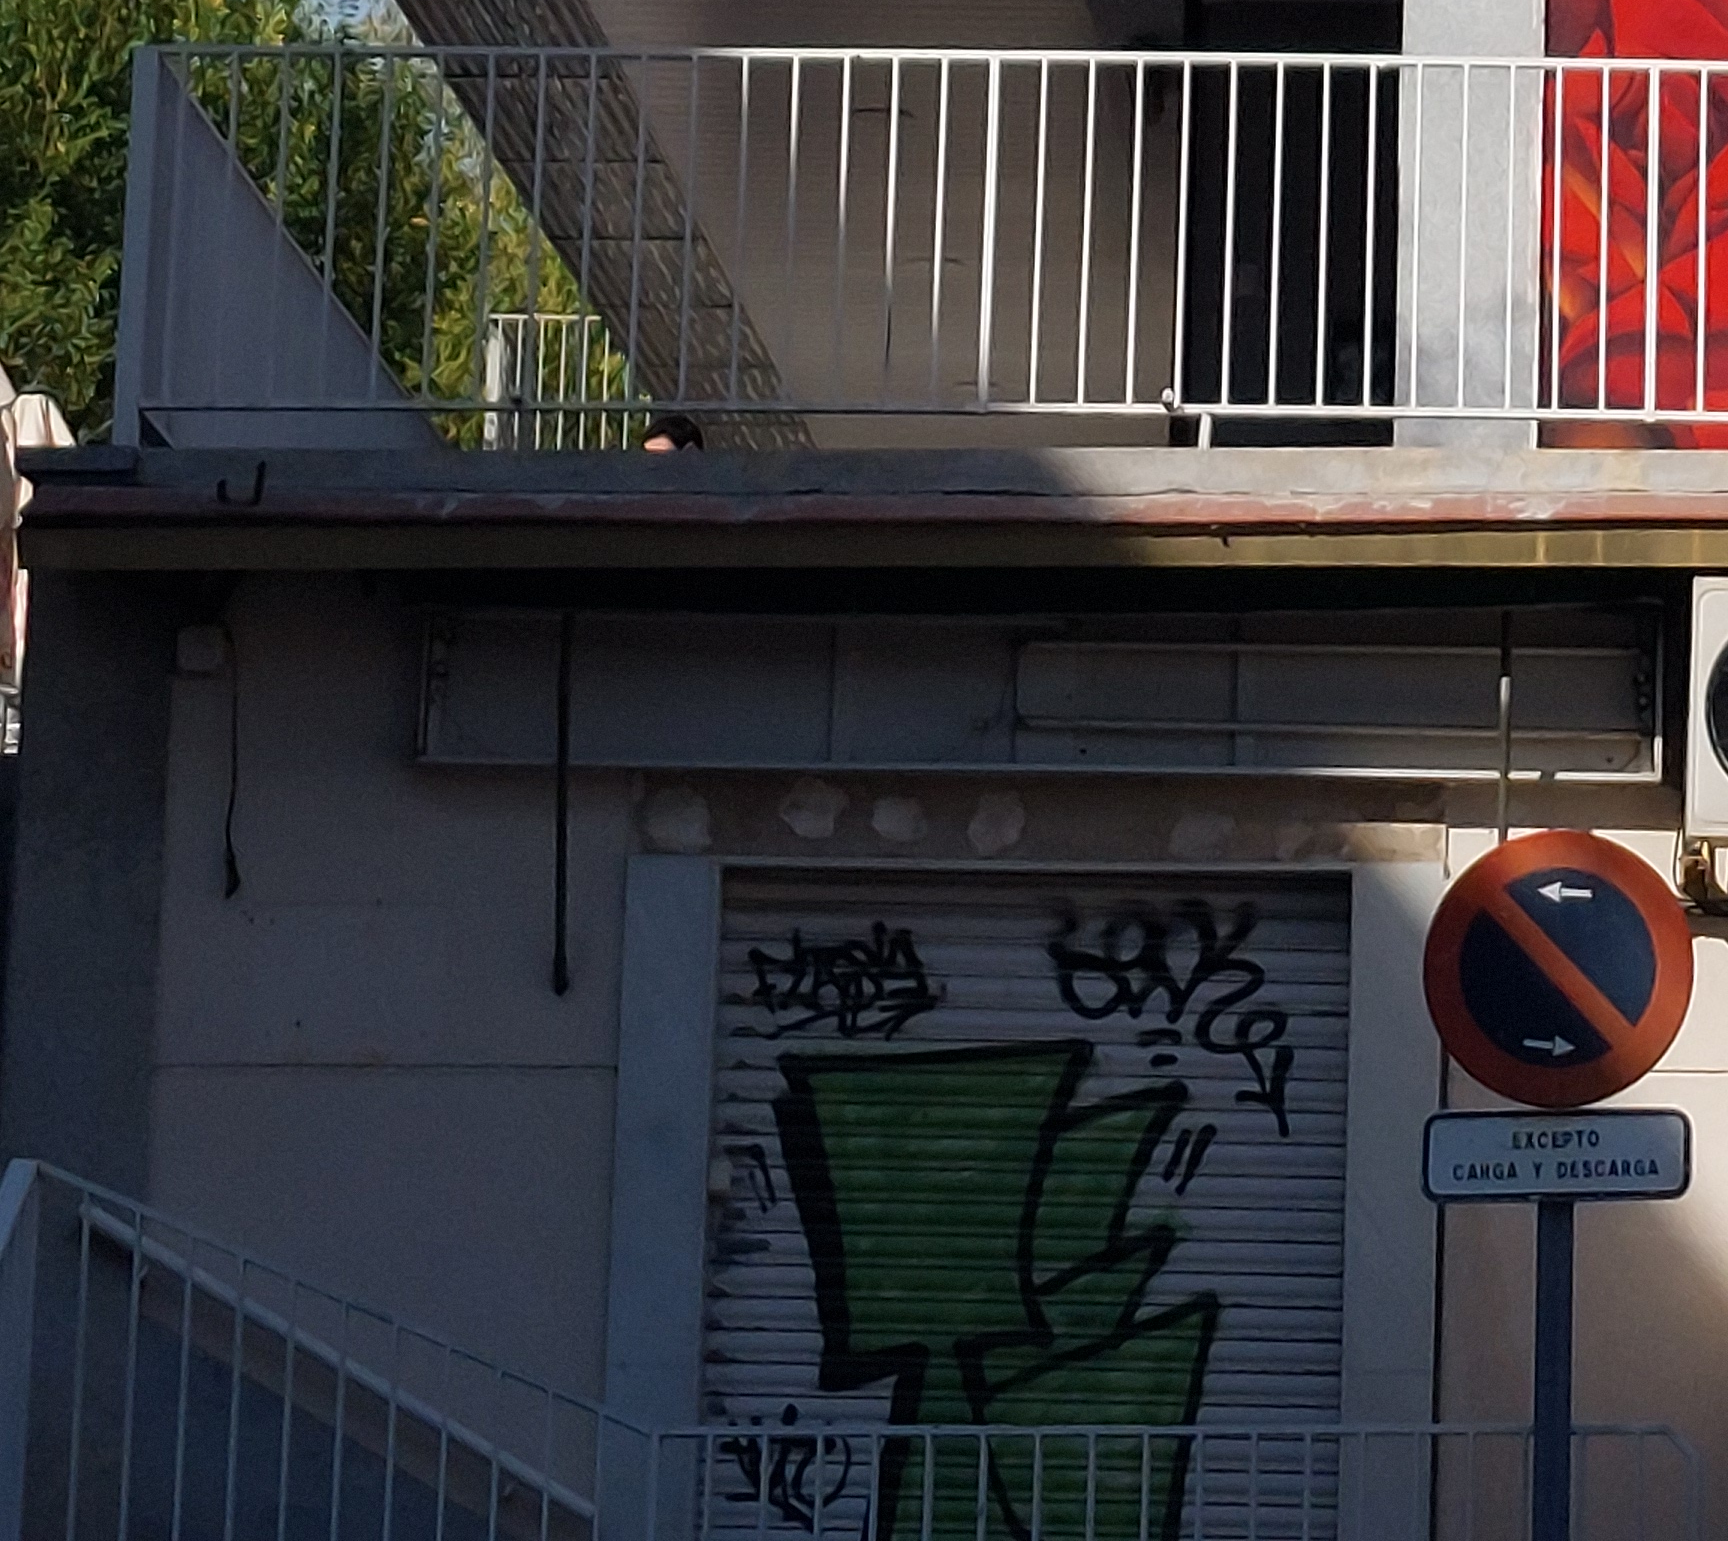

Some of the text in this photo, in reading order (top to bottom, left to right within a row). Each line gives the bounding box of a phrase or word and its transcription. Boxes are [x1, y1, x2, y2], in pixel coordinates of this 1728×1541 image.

[1510, 1129, 1601, 1151] EXCEPTO
[1452, 1158, 1660, 1182] CARGA Y DESCARGA
